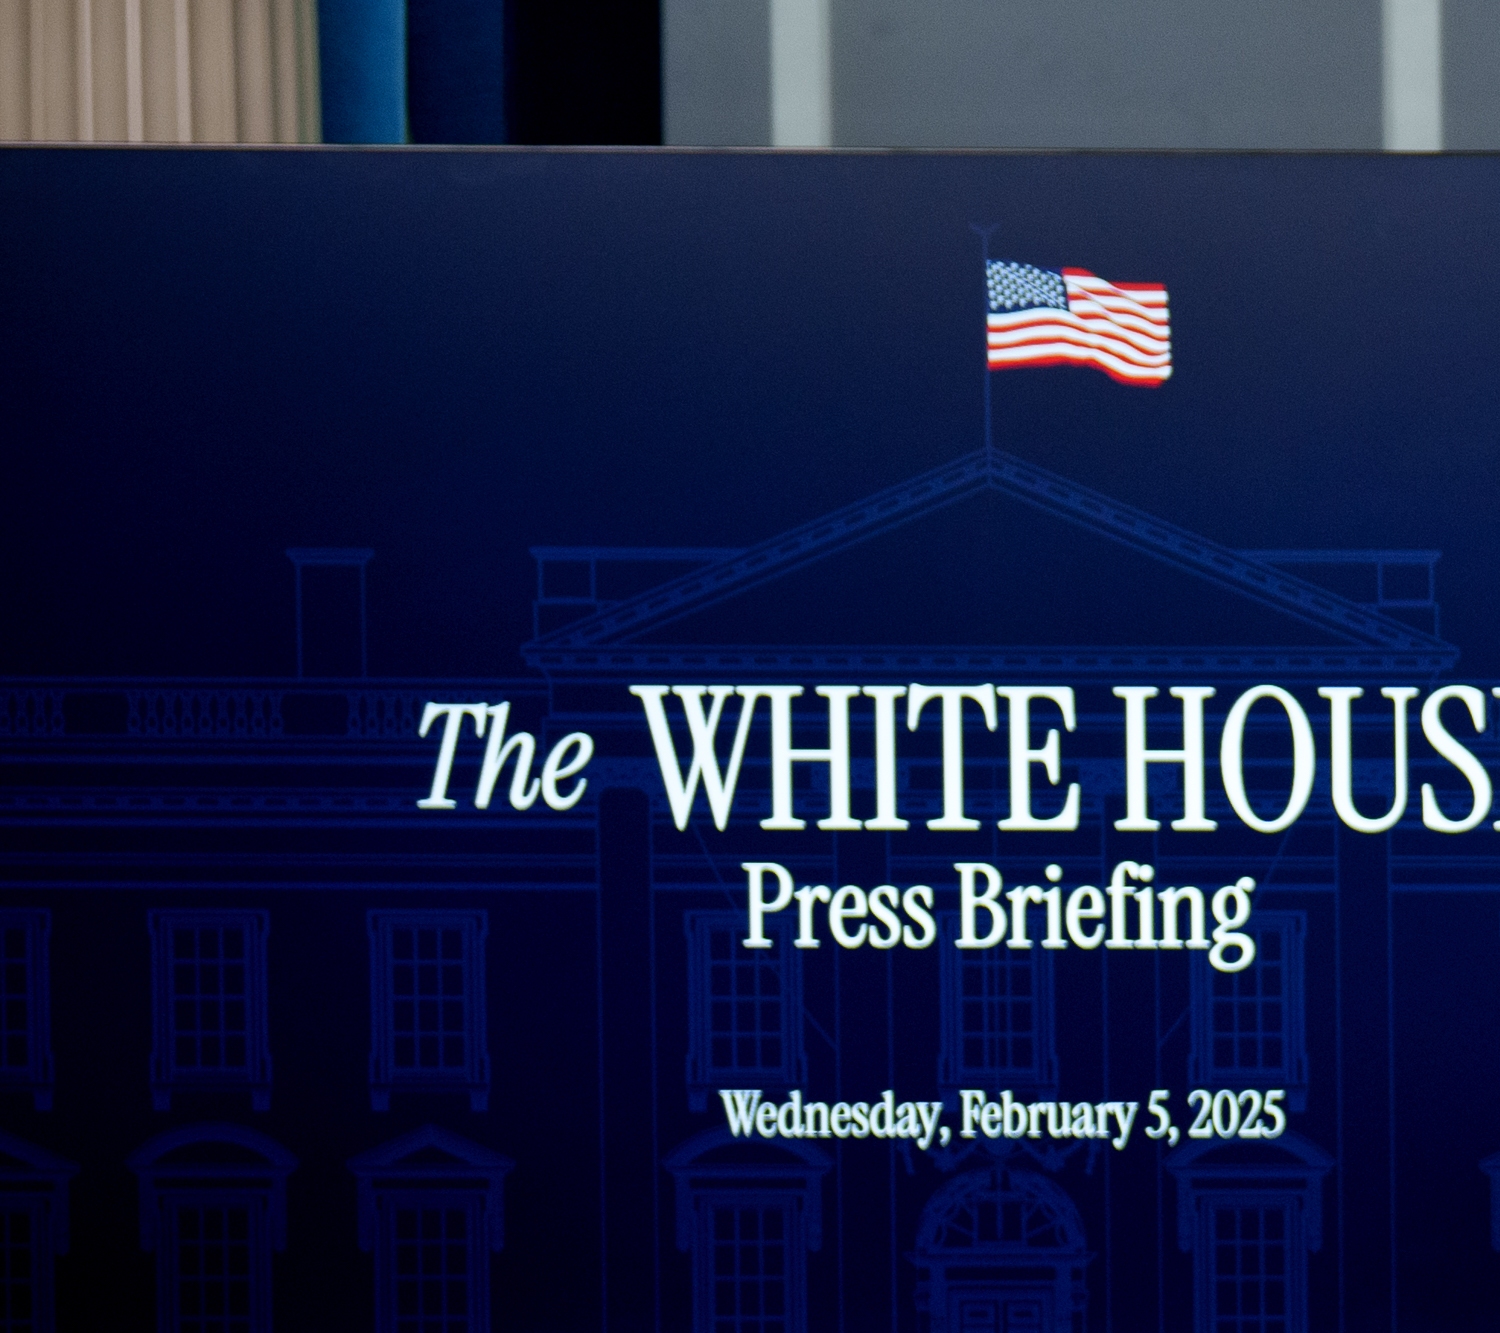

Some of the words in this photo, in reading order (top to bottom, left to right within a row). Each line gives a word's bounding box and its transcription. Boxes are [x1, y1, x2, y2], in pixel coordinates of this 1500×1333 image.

[417, 701, 593, 810] The
[629, 683, 1080, 831] WHITE
[742, 863, 936, 948] Press
[954, 861, 1255, 972] Briefing
[719, 1090, 950, 1149] Wednesday,
[960, 1090, 1138, 1149] February
[1145, 1090, 1179, 1144] 5,
[1188, 1090, 1285, 1138] 2025
